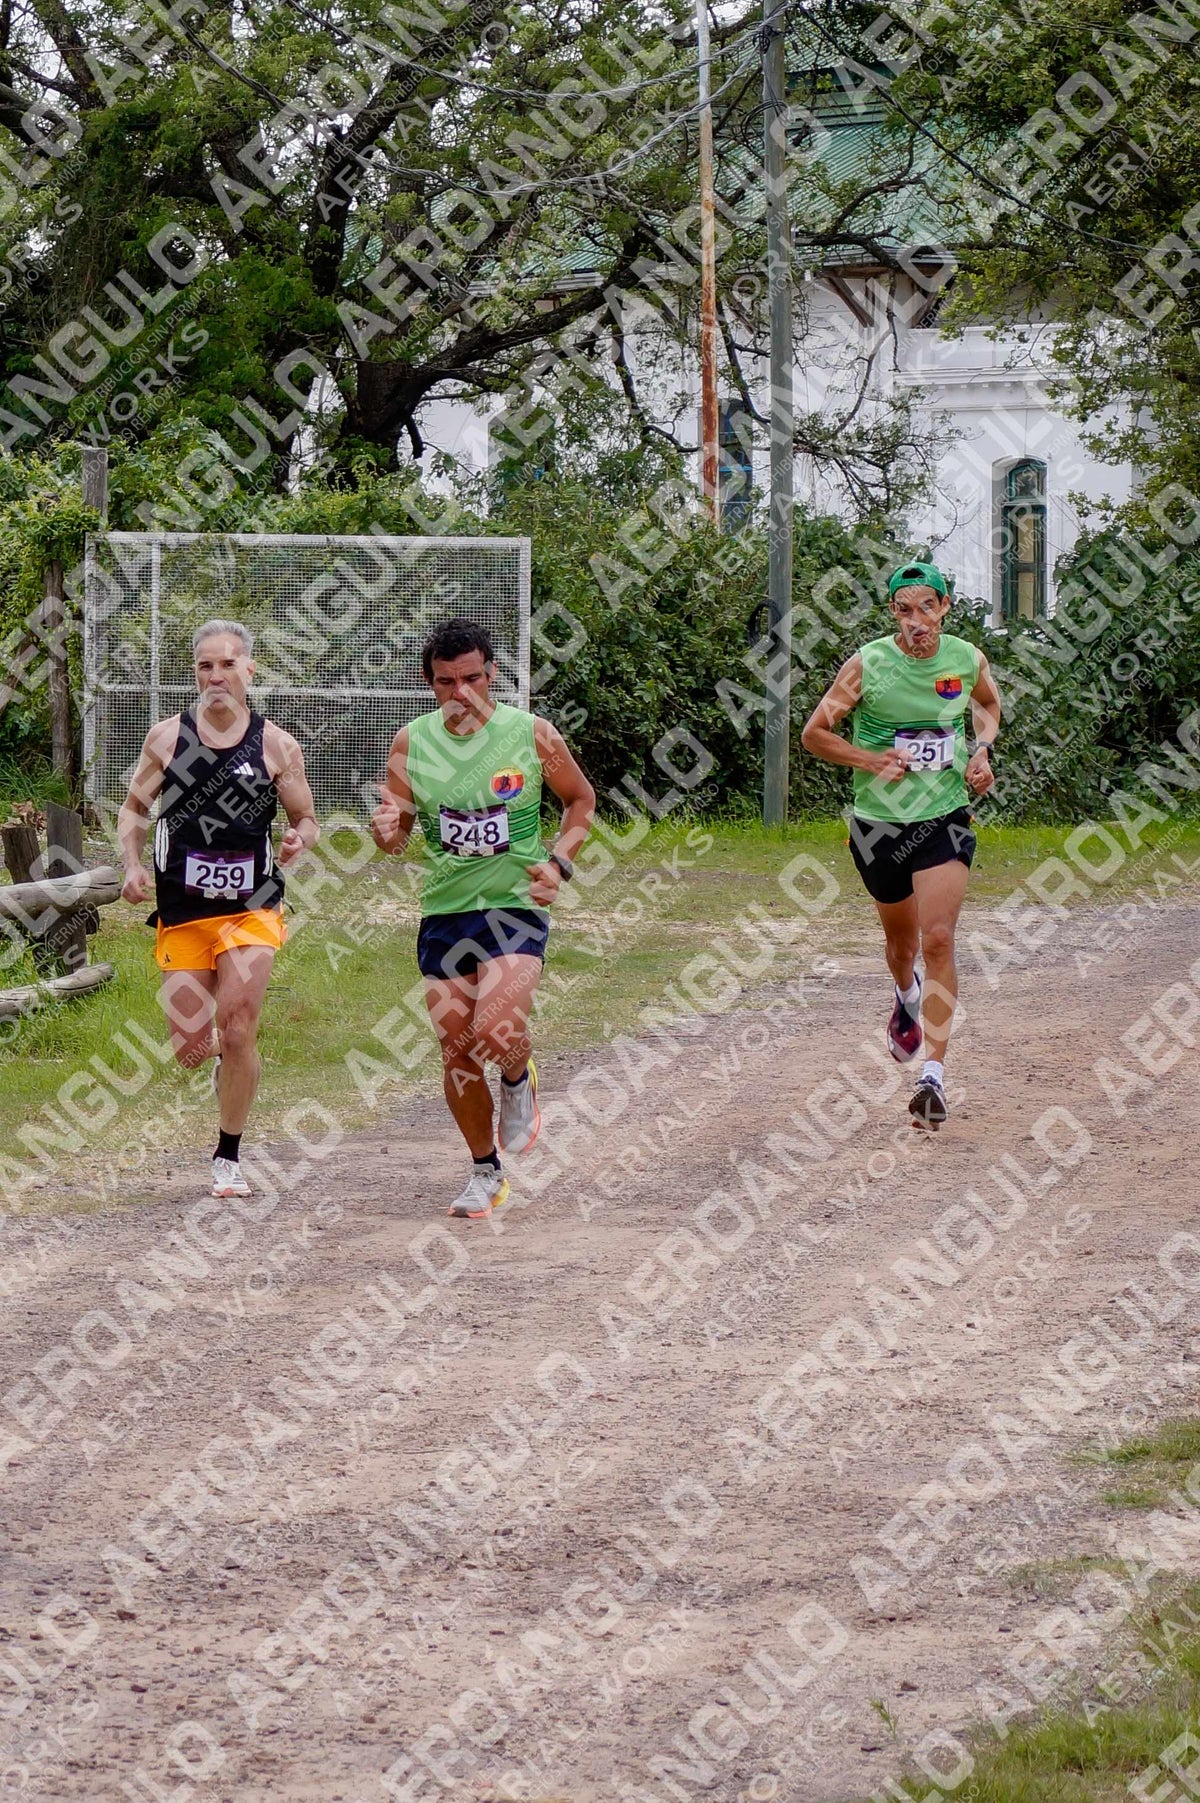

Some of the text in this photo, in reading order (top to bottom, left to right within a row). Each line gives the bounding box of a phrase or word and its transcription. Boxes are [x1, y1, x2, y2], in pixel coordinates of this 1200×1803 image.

[906, 740, 946, 763] 251
[448, 820, 501, 848] 248
[195, 864, 246, 890] 259
